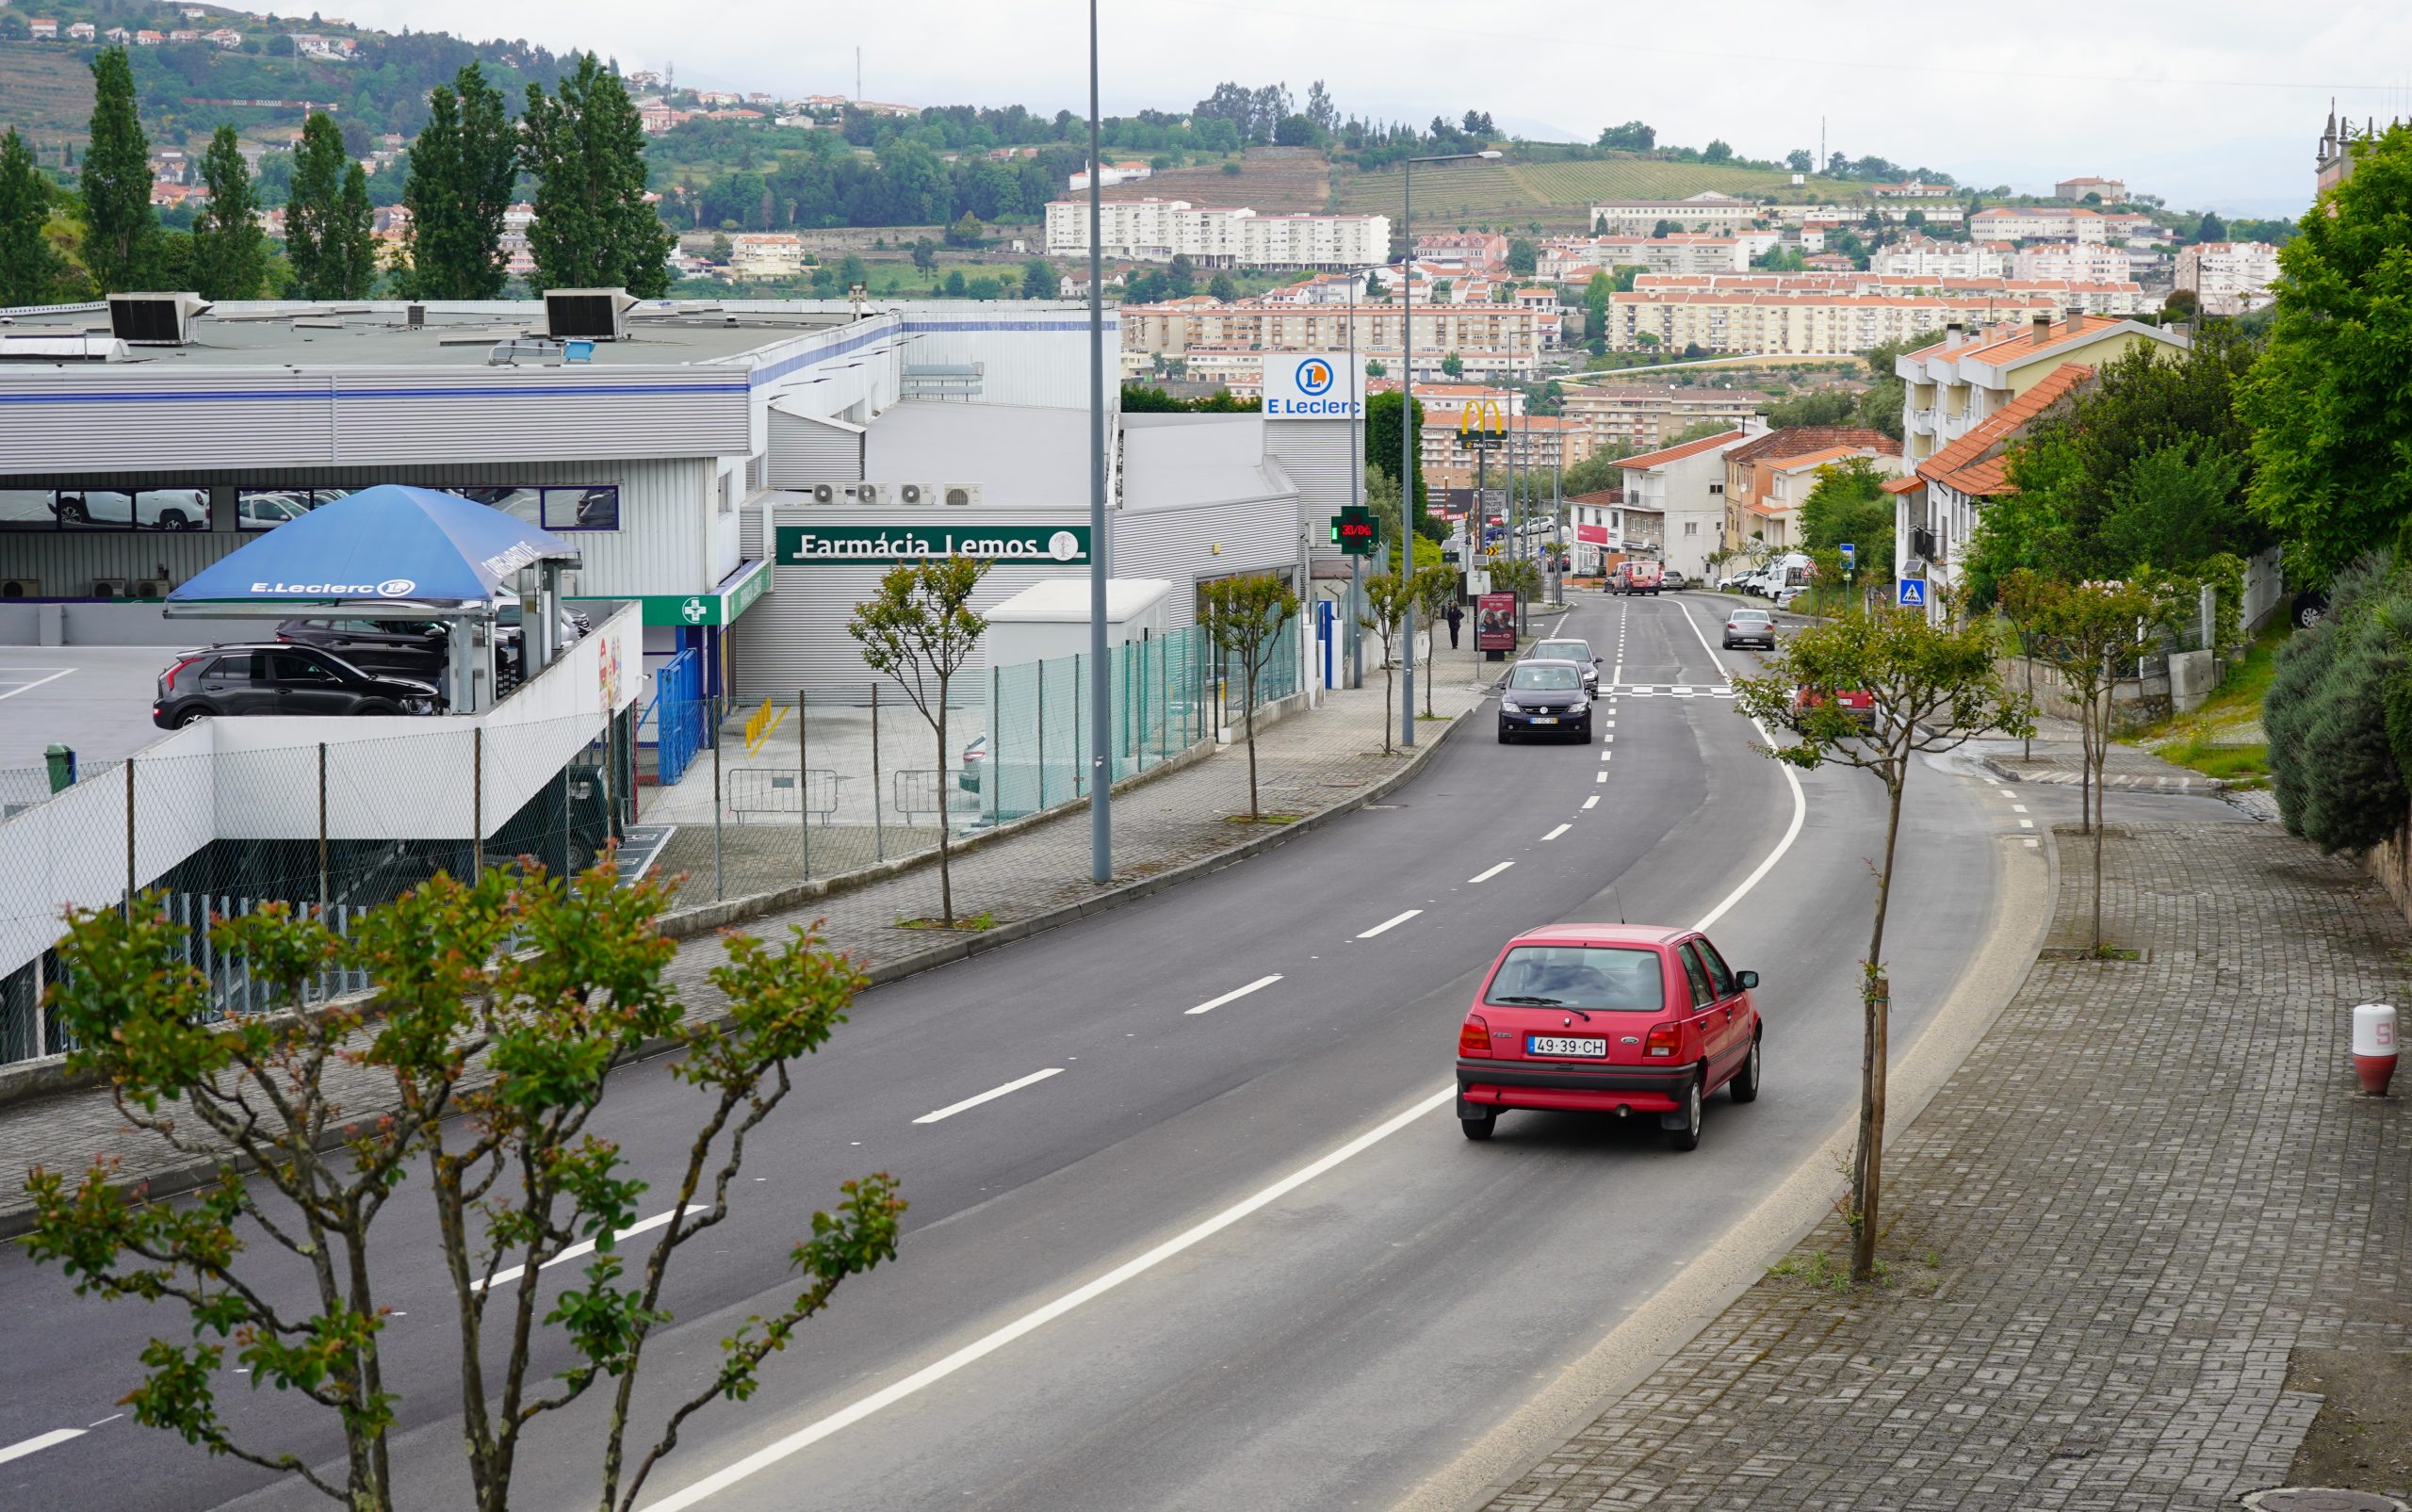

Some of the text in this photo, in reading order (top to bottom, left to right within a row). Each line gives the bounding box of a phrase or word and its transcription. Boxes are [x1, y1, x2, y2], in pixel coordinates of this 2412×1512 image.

[801, 531, 1037, 558] Farmácia Lemos
[251, 582, 374, 593] E.Leclerc
